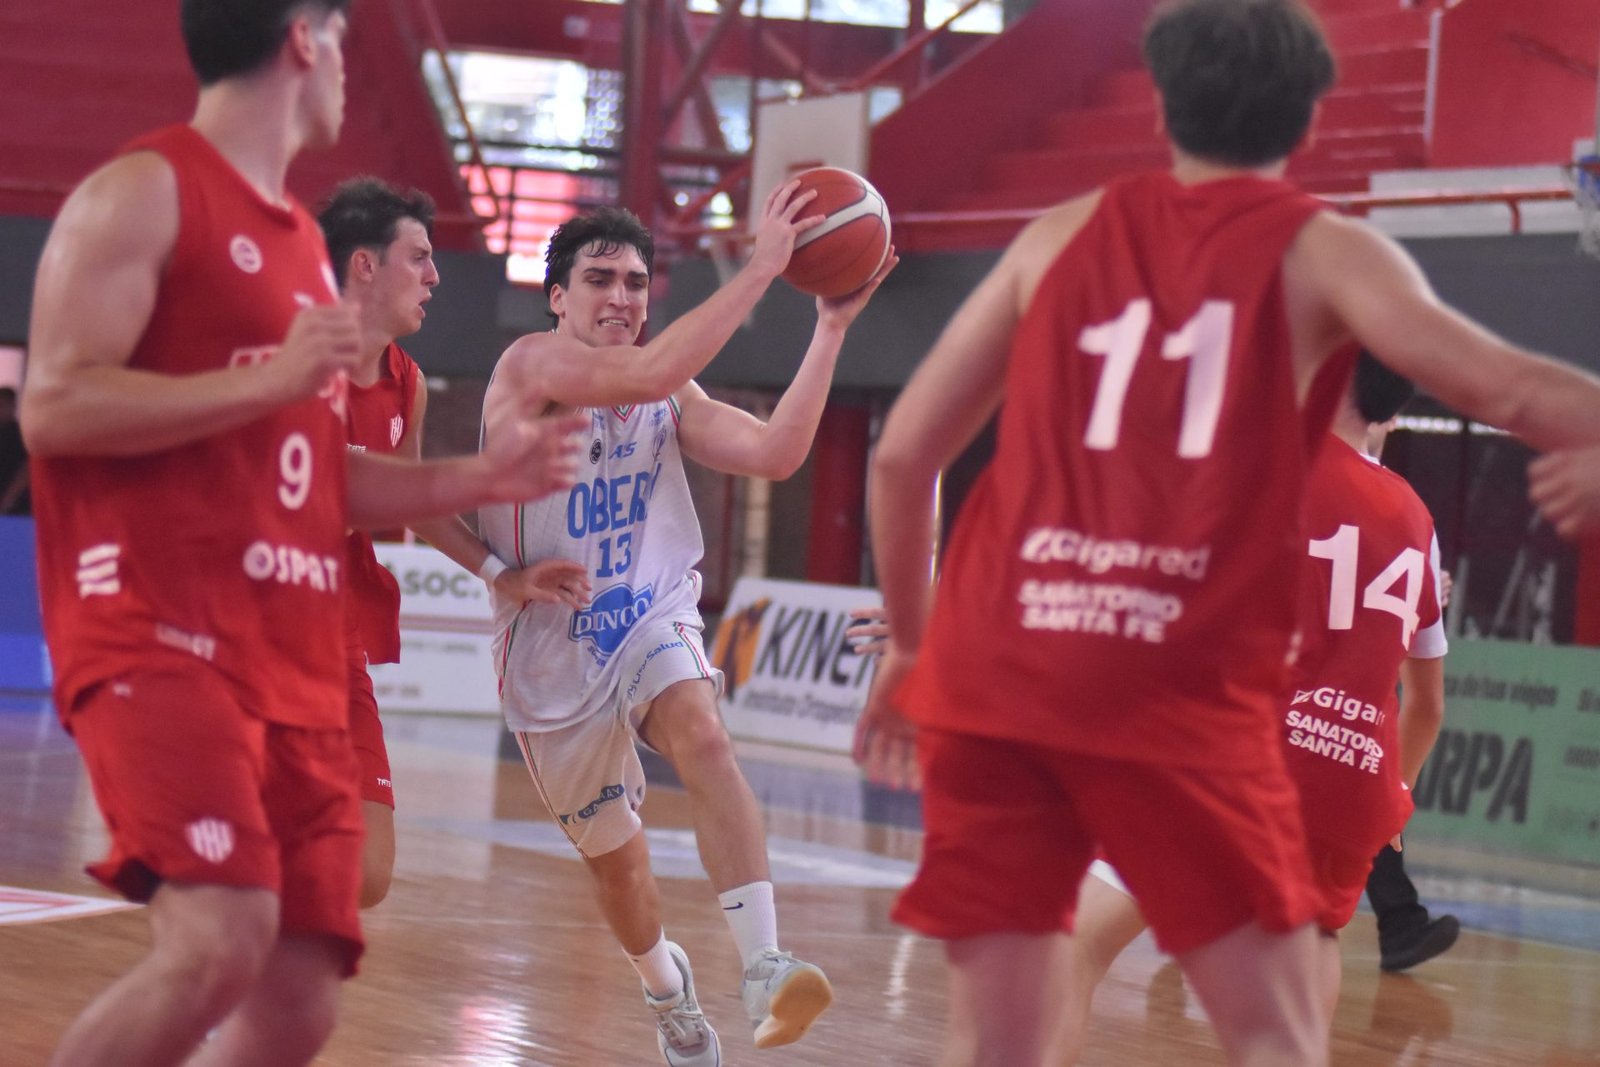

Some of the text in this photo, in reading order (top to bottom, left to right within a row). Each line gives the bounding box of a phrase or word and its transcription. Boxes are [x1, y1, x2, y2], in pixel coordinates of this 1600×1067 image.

[1077, 297, 1235, 459] 11
[278, 432, 313, 510] 9
[596, 532, 633, 578] 13
[1308, 524, 1425, 651] 14
[755, 605, 873, 690] KINE
[1288, 729, 1380, 775] SANTA FE
[1412, 729, 1534, 823] RPA
